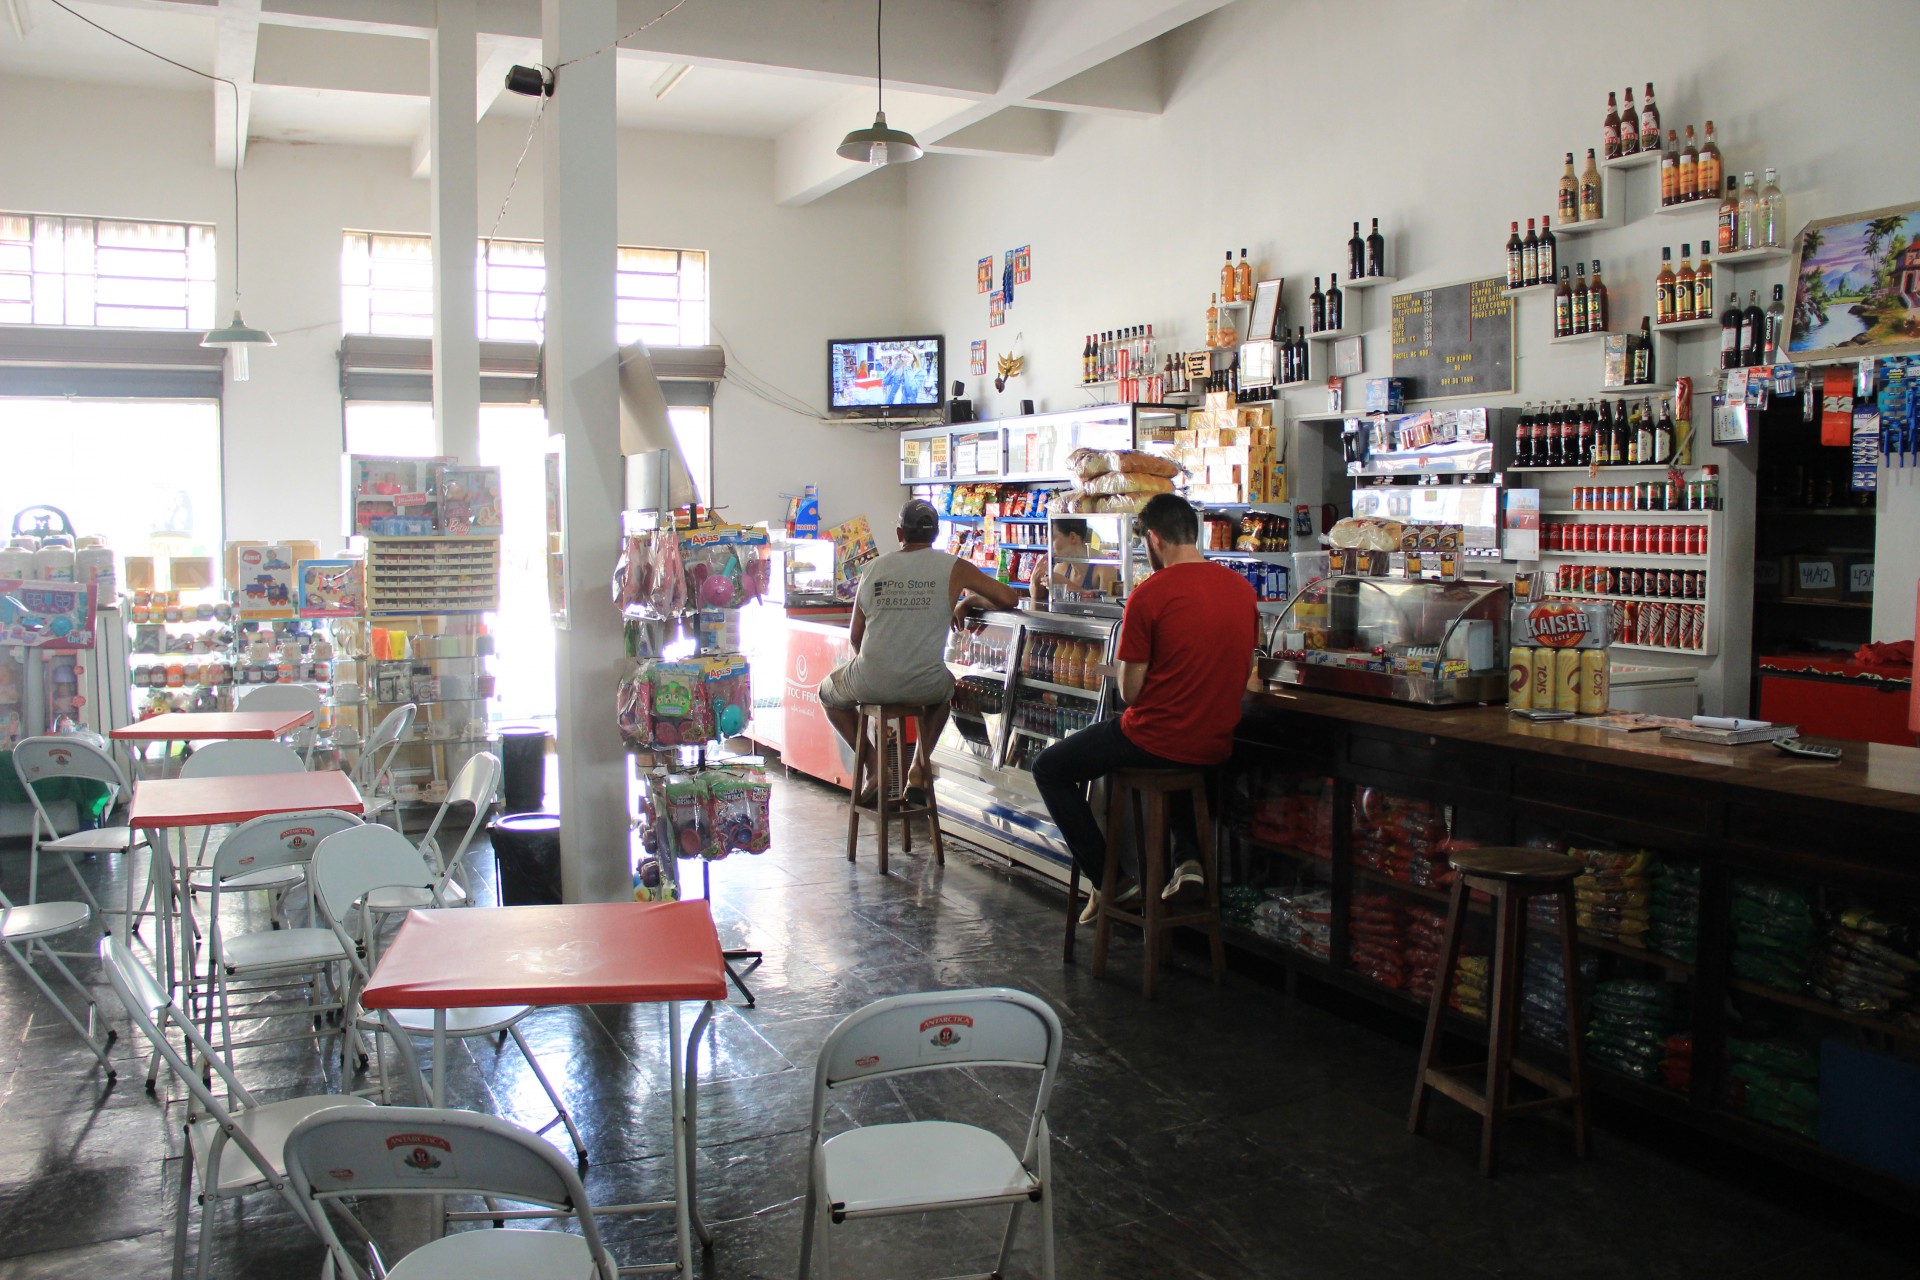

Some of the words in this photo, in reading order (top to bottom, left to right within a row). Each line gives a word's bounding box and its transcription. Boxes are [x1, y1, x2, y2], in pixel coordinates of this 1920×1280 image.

[888, 580, 904, 588] Pro
[908, 580, 936, 588] Stone
[876, 598, 931, 606] 978.612.0232
[1524, 614, 1592, 638] KAISER
[1406, 647, 1439, 657] HALLS
[1537, 666, 1548, 694] SKOL
[1593, 668, 1604, 696] SKOL
[787, 686, 800, 698] TOC
[924, 1016, 970, 1027] ANTARCTICA
[390, 1135, 446, 1146] ANTARCTICA
